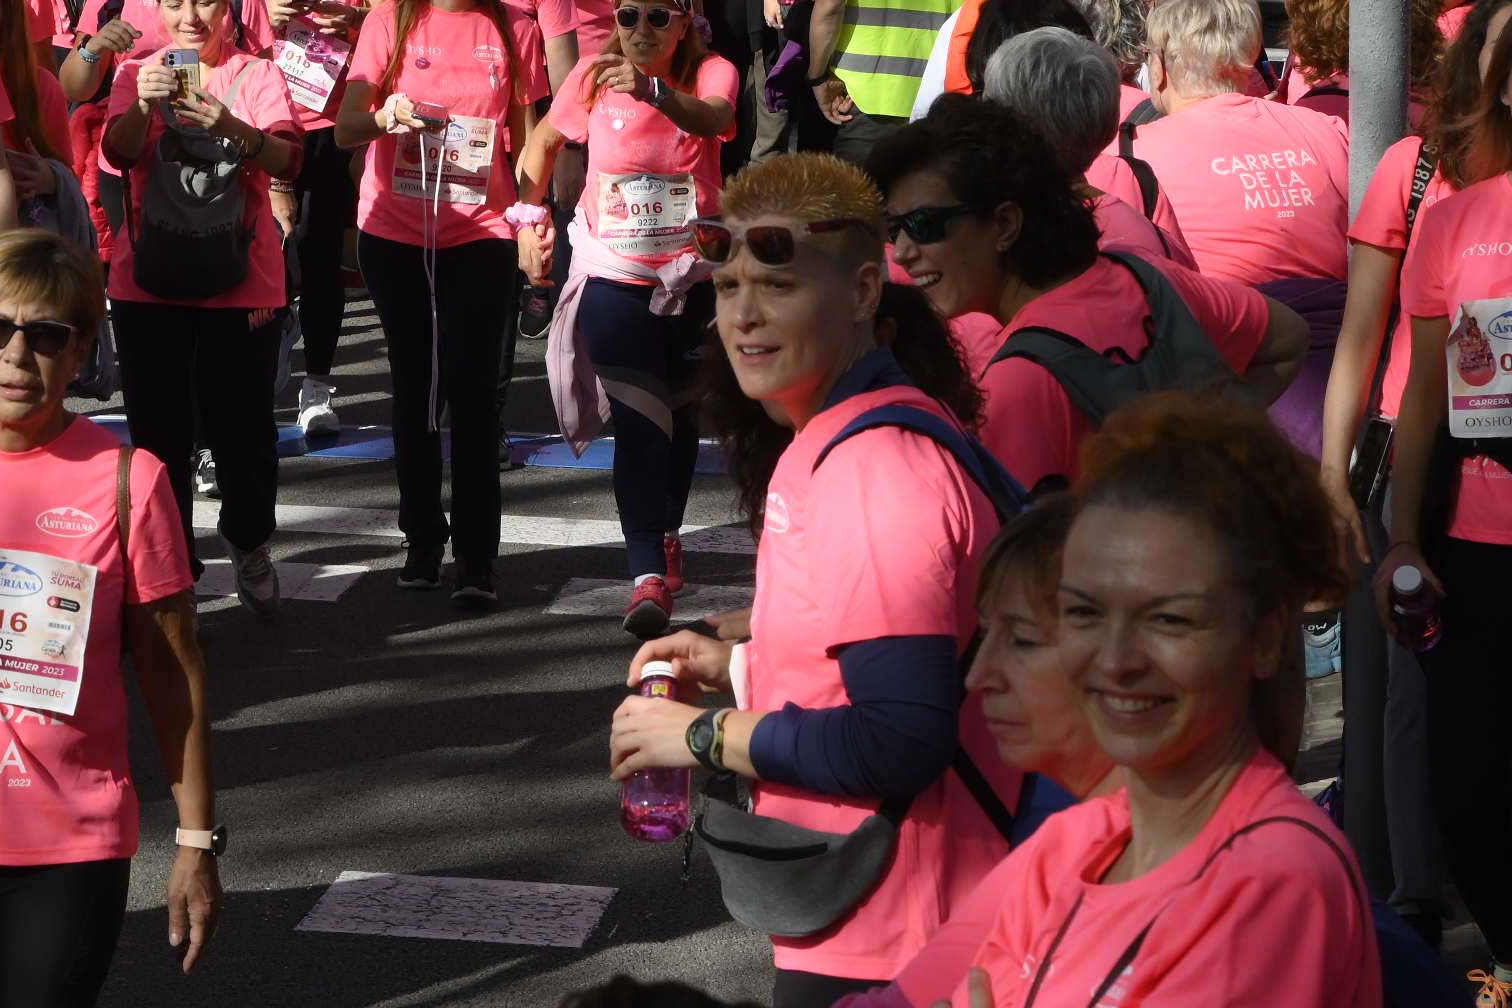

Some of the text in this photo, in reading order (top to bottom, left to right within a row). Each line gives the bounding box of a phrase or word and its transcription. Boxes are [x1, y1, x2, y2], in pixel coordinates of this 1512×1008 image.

[285, 50, 311, 69] 016
[598, 104, 637, 120] OYSHO
[432, 163, 452, 173] 920
[1210, 149, 1317, 176] CARRERA
[1239, 169, 1305, 190] DE LA
[1411, 157, 1434, 199] 1987
[1244, 188, 1316, 211] MUJER
[631, 201, 663, 215] 016
[637, 218, 659, 227] 9222
[1468, 397, 1511, 407] CARRERA
[1465, 415, 1512, 428] OYSHO
[39, 515, 94, 532] ASTURIANA
[49, 576, 82, 591] SUMA
[4, 658, 40, 673] MUJER
[41, 664, 65, 677] 2023
[12, 681, 66, 699] Santander
[7, 777, 32, 788] 2023
